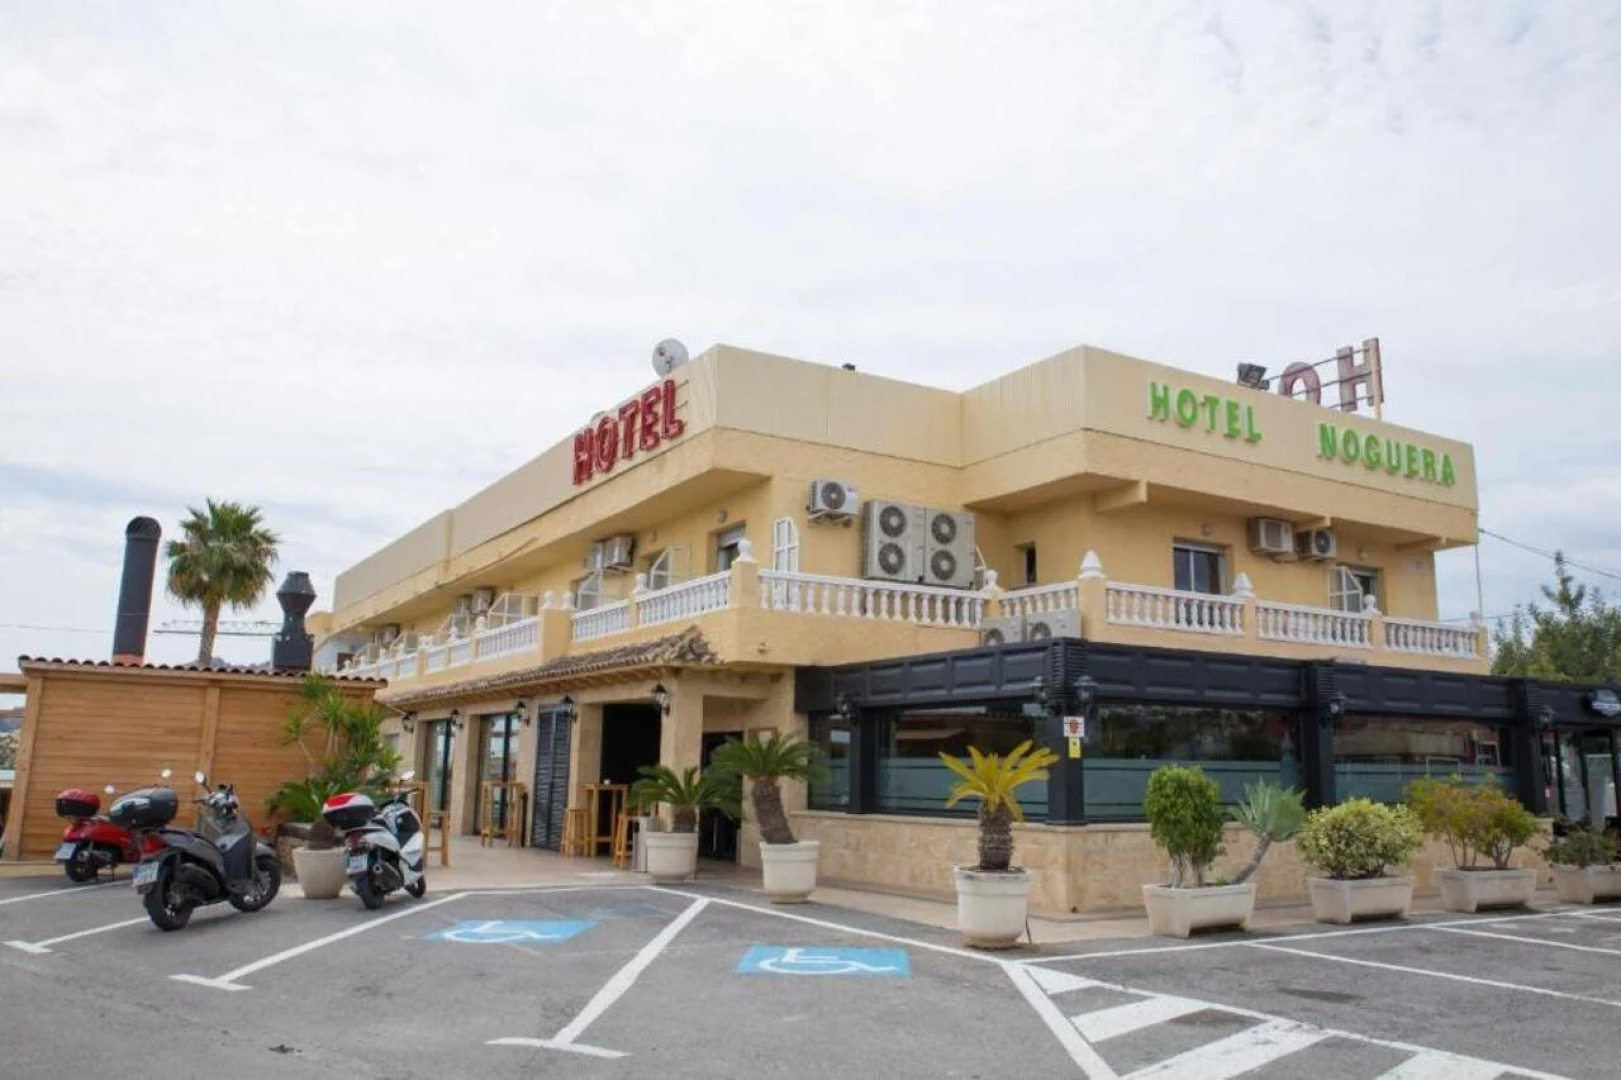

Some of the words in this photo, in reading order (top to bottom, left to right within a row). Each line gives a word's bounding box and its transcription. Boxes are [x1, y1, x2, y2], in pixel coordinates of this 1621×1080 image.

[572, 379, 685, 485] HOTEL
[1148, 382, 1263, 443] HOTEL
[1318, 423, 1456, 487] NOGUERA
